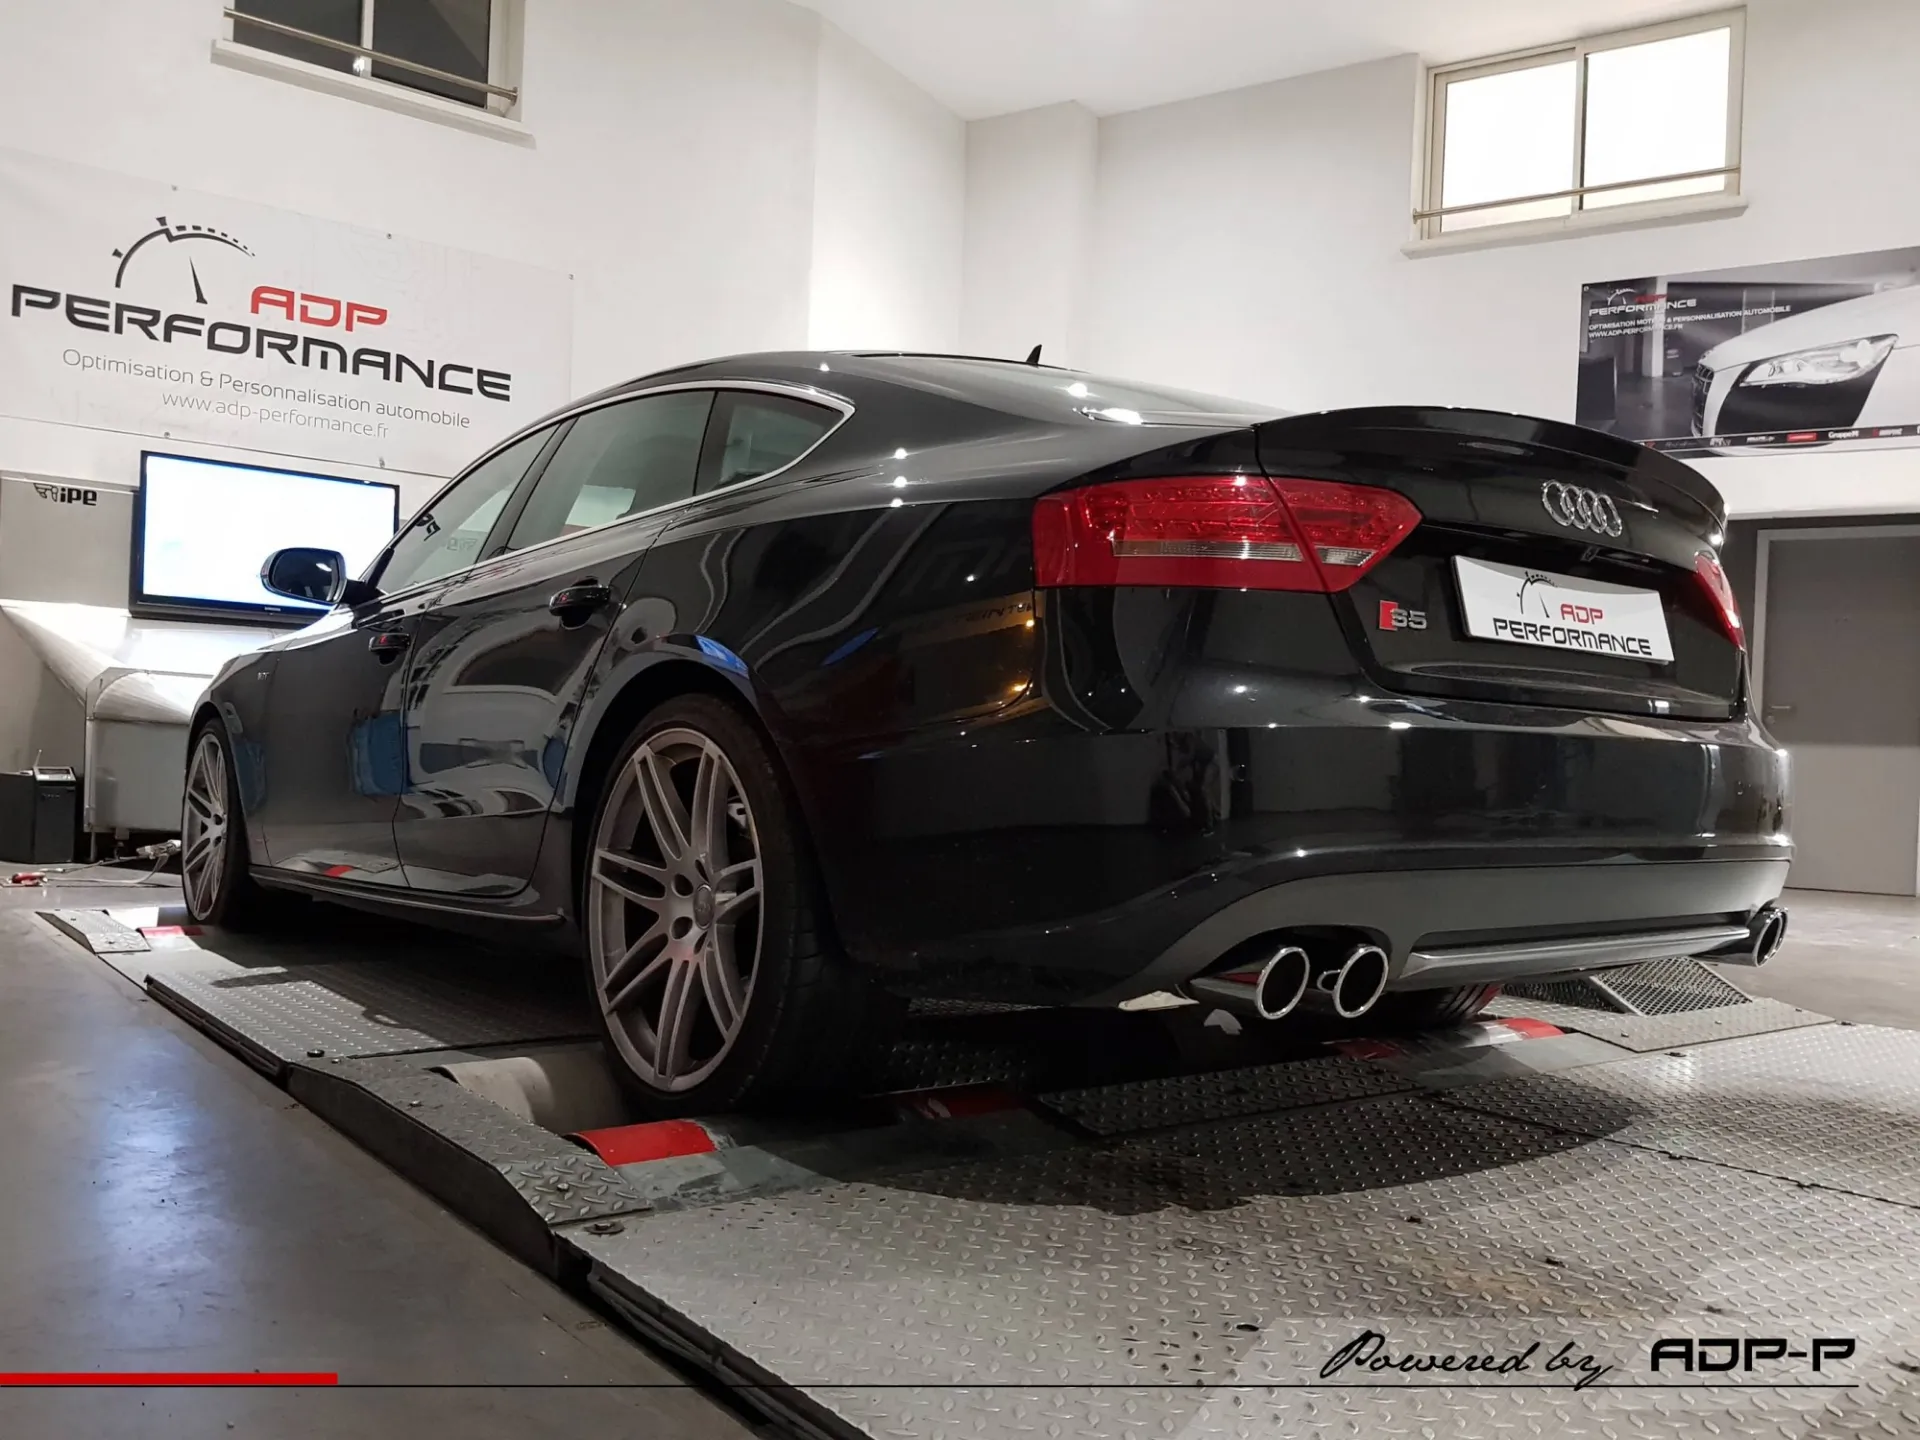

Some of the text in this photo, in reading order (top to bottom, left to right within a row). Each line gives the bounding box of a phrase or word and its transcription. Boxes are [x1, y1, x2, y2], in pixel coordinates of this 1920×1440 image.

[251, 285, 388, 332] ADP
[1588, 320, 1636, 331] OPTIMISATION
[1673, 310, 1742, 322] PERSONNALISATION
[1743, 305, 1792, 316] AUTOMOBILE
[11, 283, 512, 403] PERFORMANCE
[1588, 323, 1684, 338] WWW.ADP-PERFORMCE.FR
[62, 348, 471, 428] Optimisation & Personnalisation automobile
[161, 392, 389, 439] www.adp-performance.fr
[59, 487, 97, 506] ipe
[1390, 607, 1427, 630] S5
[1560, 603, 1604, 625] ADP
[1492, 617, 1653, 656] PERFORMANCE
